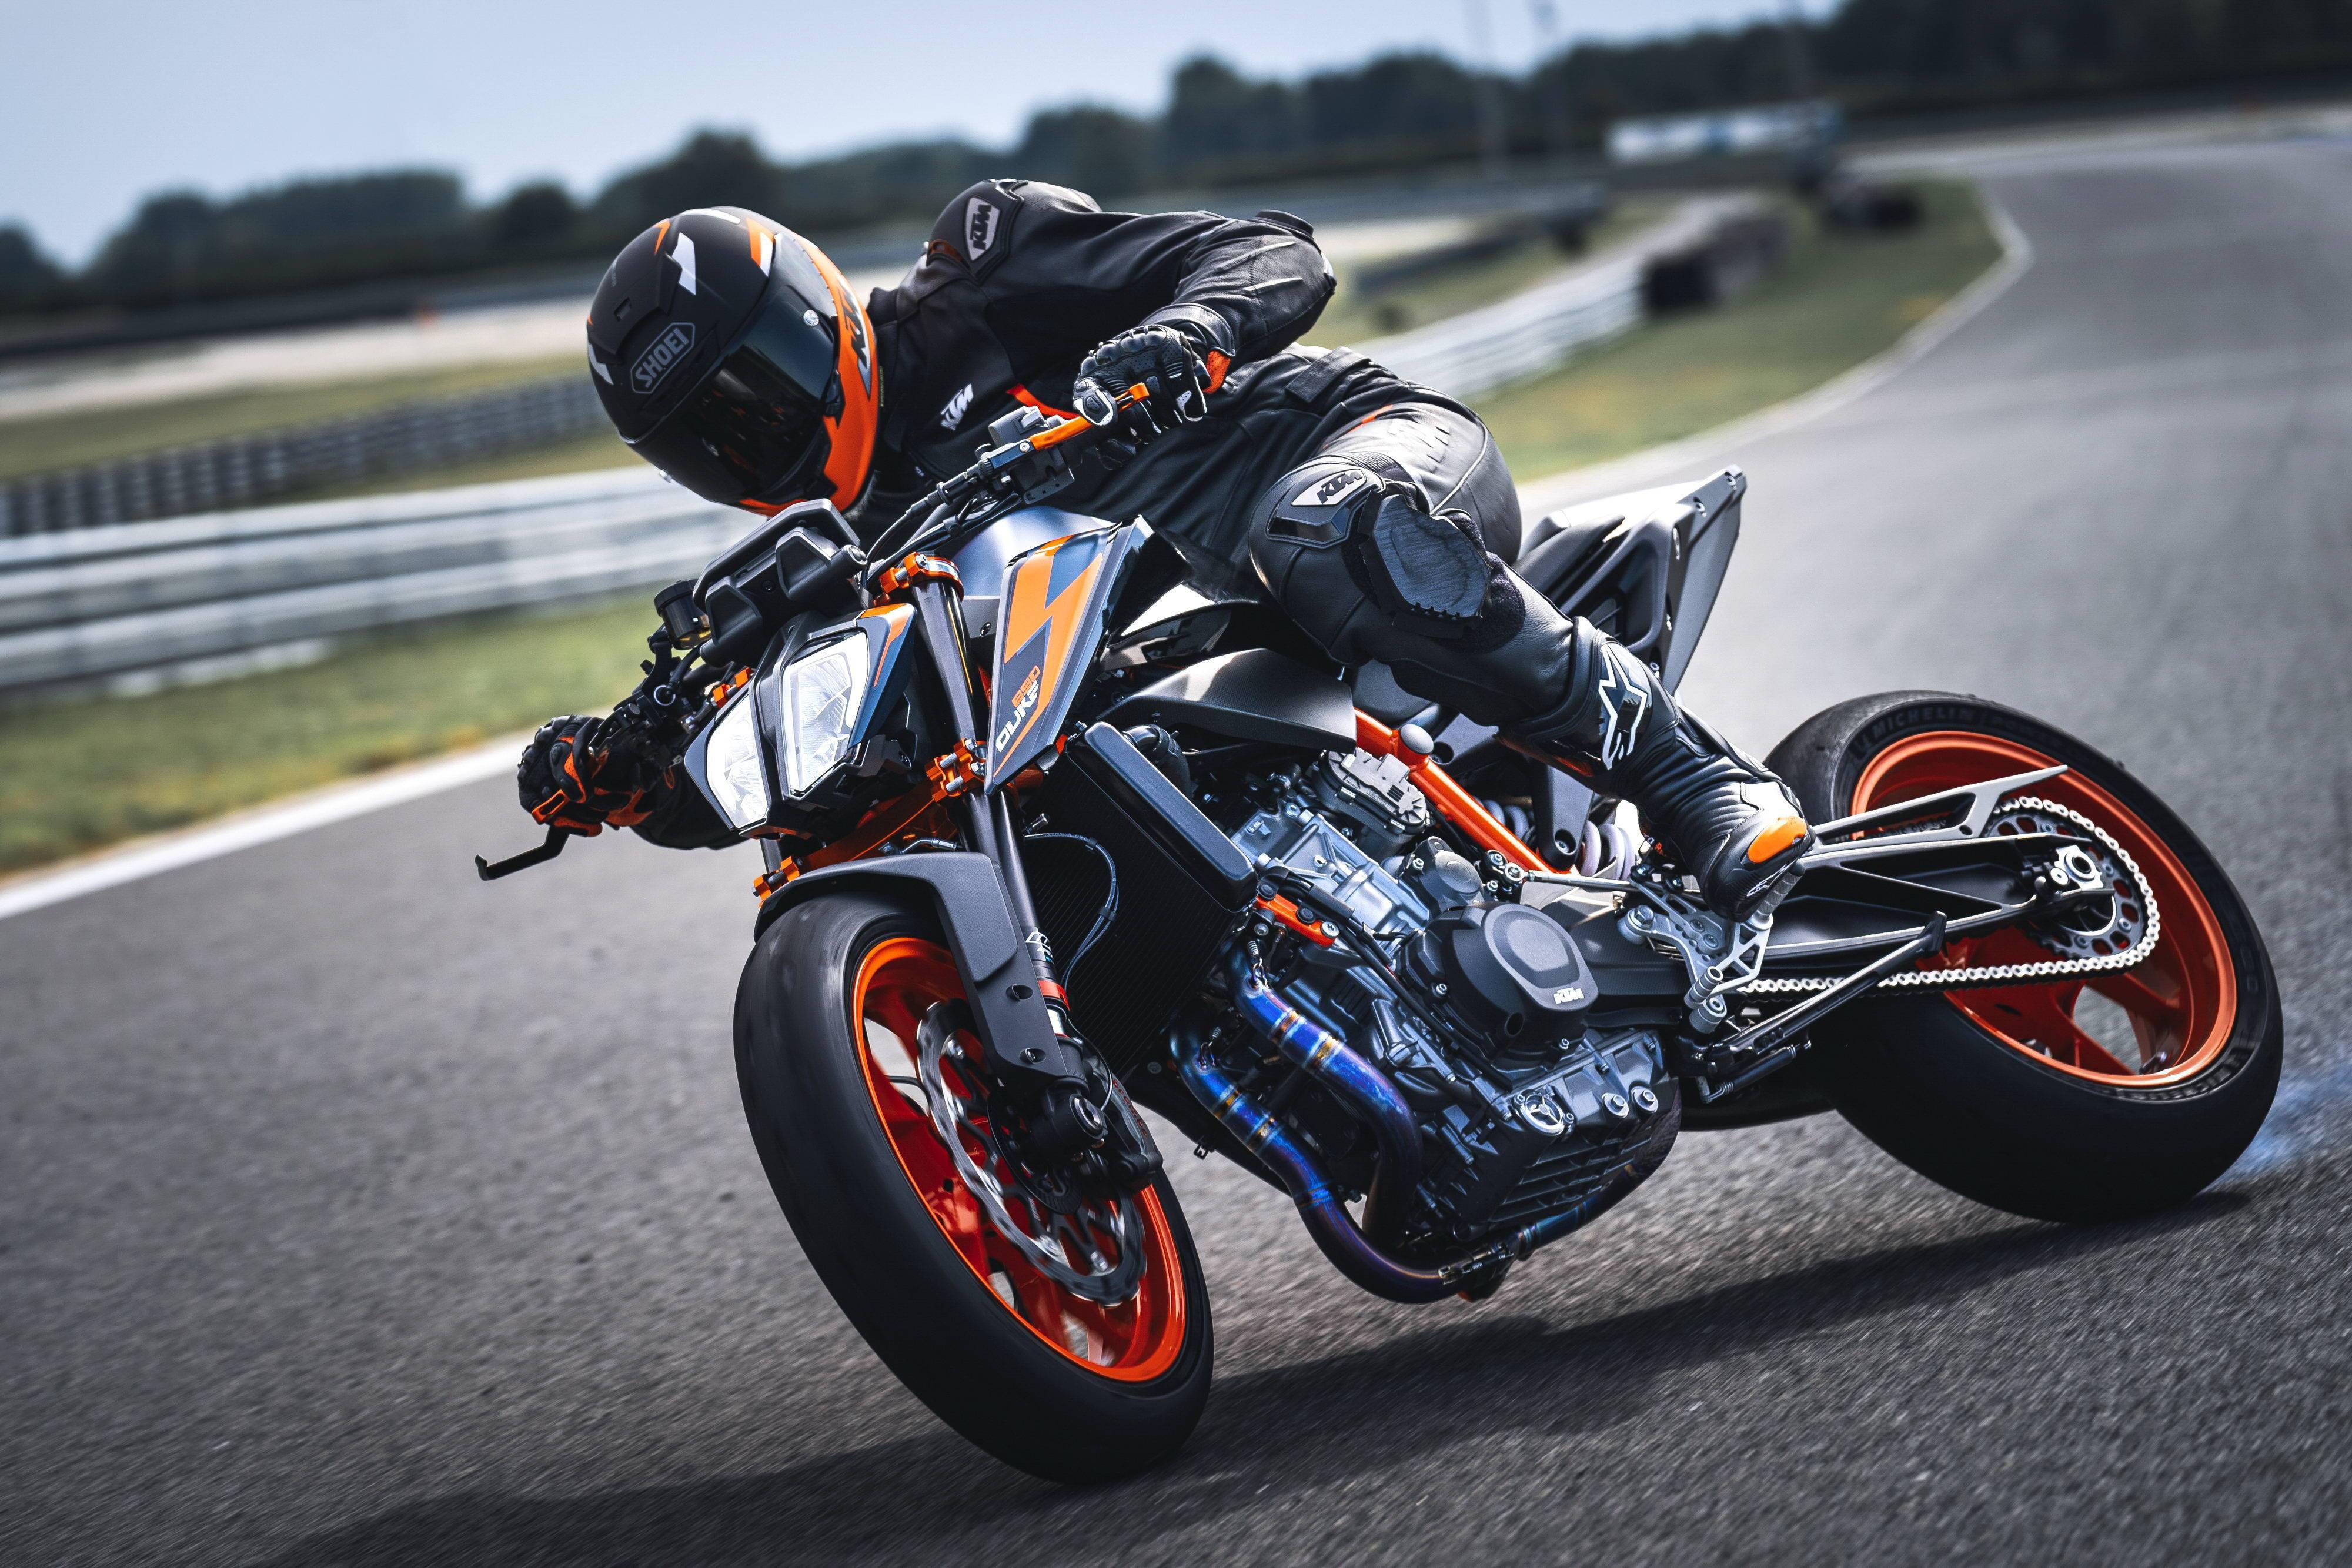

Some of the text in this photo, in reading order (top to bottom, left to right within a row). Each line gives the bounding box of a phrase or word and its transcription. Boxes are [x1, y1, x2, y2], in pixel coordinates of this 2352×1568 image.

[970, 203, 992, 250] KTM
[636, 327, 690, 388] SHOEI
[940, 383, 974, 430] KTM
[1317, 471, 1363, 504] KTM
[1011, 665, 1041, 708] 890
[995, 680, 1040, 753] DUKE
[1869, 706, 1975, 737] MICHELIN
[1553, 987, 1585, 1005] KTM
[1111, 1078, 1148, 1138] brembo
